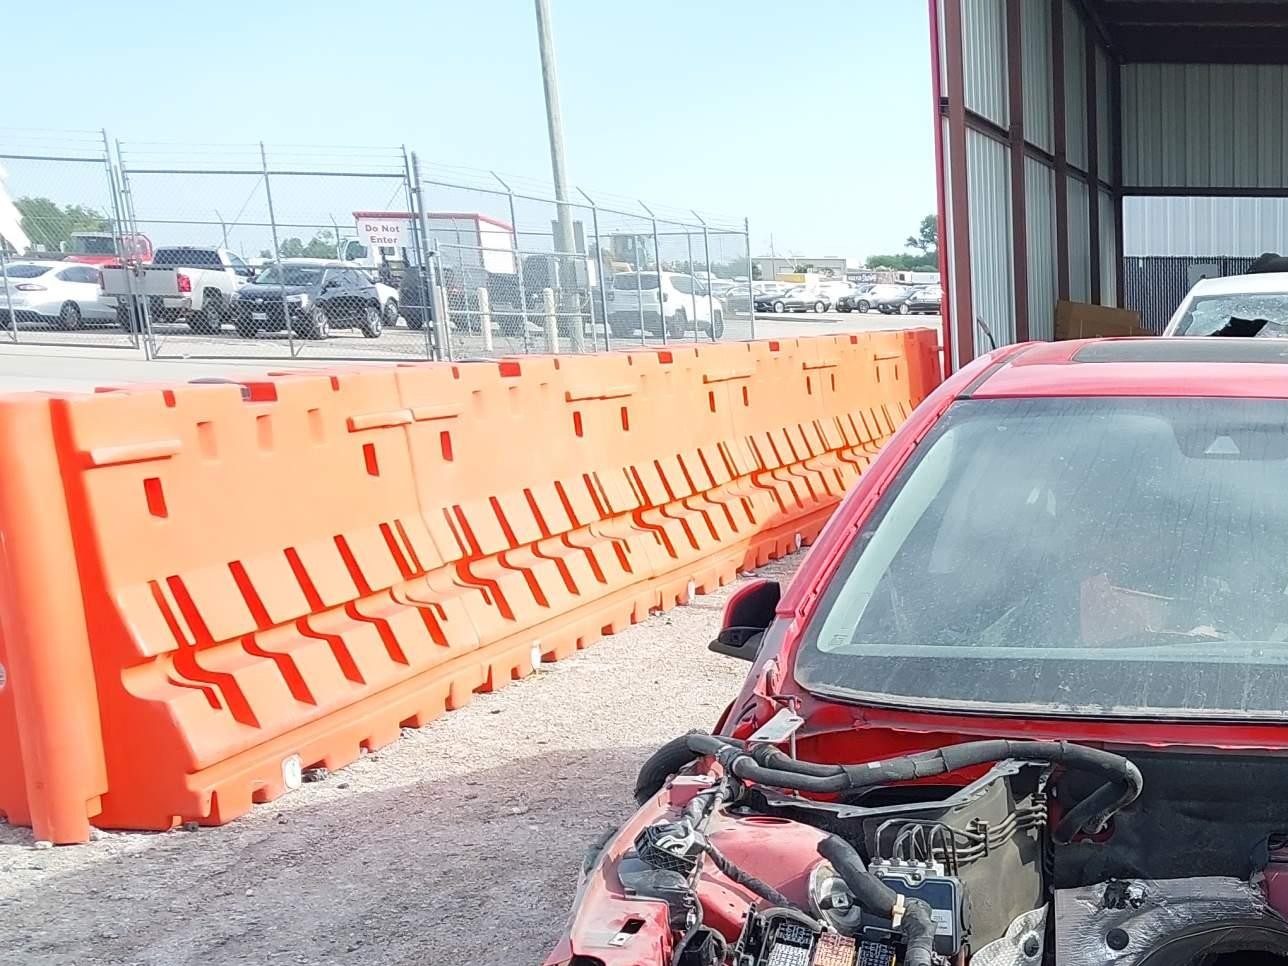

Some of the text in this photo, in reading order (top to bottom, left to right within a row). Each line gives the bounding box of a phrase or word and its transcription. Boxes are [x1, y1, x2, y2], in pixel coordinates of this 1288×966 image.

[365, 224, 400, 233] Do Not
[370, 235, 398, 244] Enter
